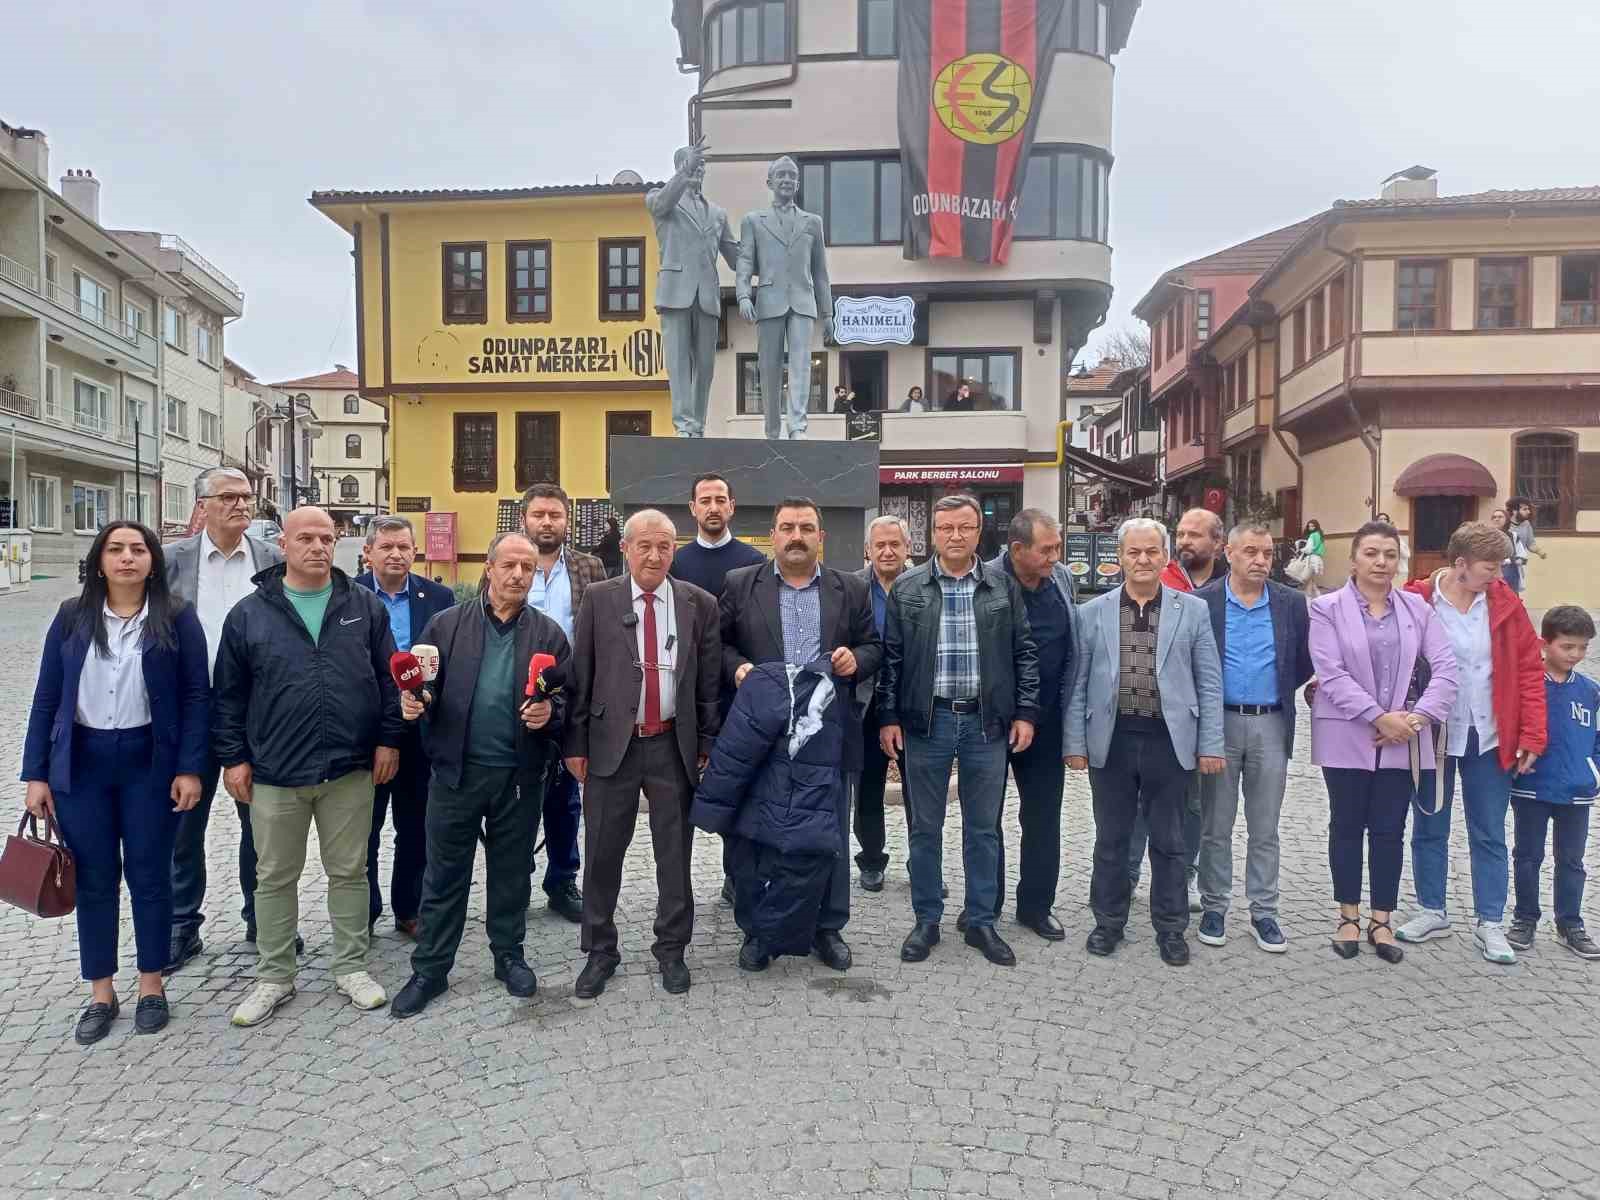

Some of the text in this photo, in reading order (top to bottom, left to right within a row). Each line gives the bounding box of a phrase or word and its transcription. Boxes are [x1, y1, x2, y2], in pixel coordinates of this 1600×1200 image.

[482, 337, 607, 356] ODUNPAZARI
[468, 350, 618, 374] SANAT MERKEZİ
[894, 470, 1000, 480] PARK BERBER SALONU
[1570, 701, 1591, 727] ND
